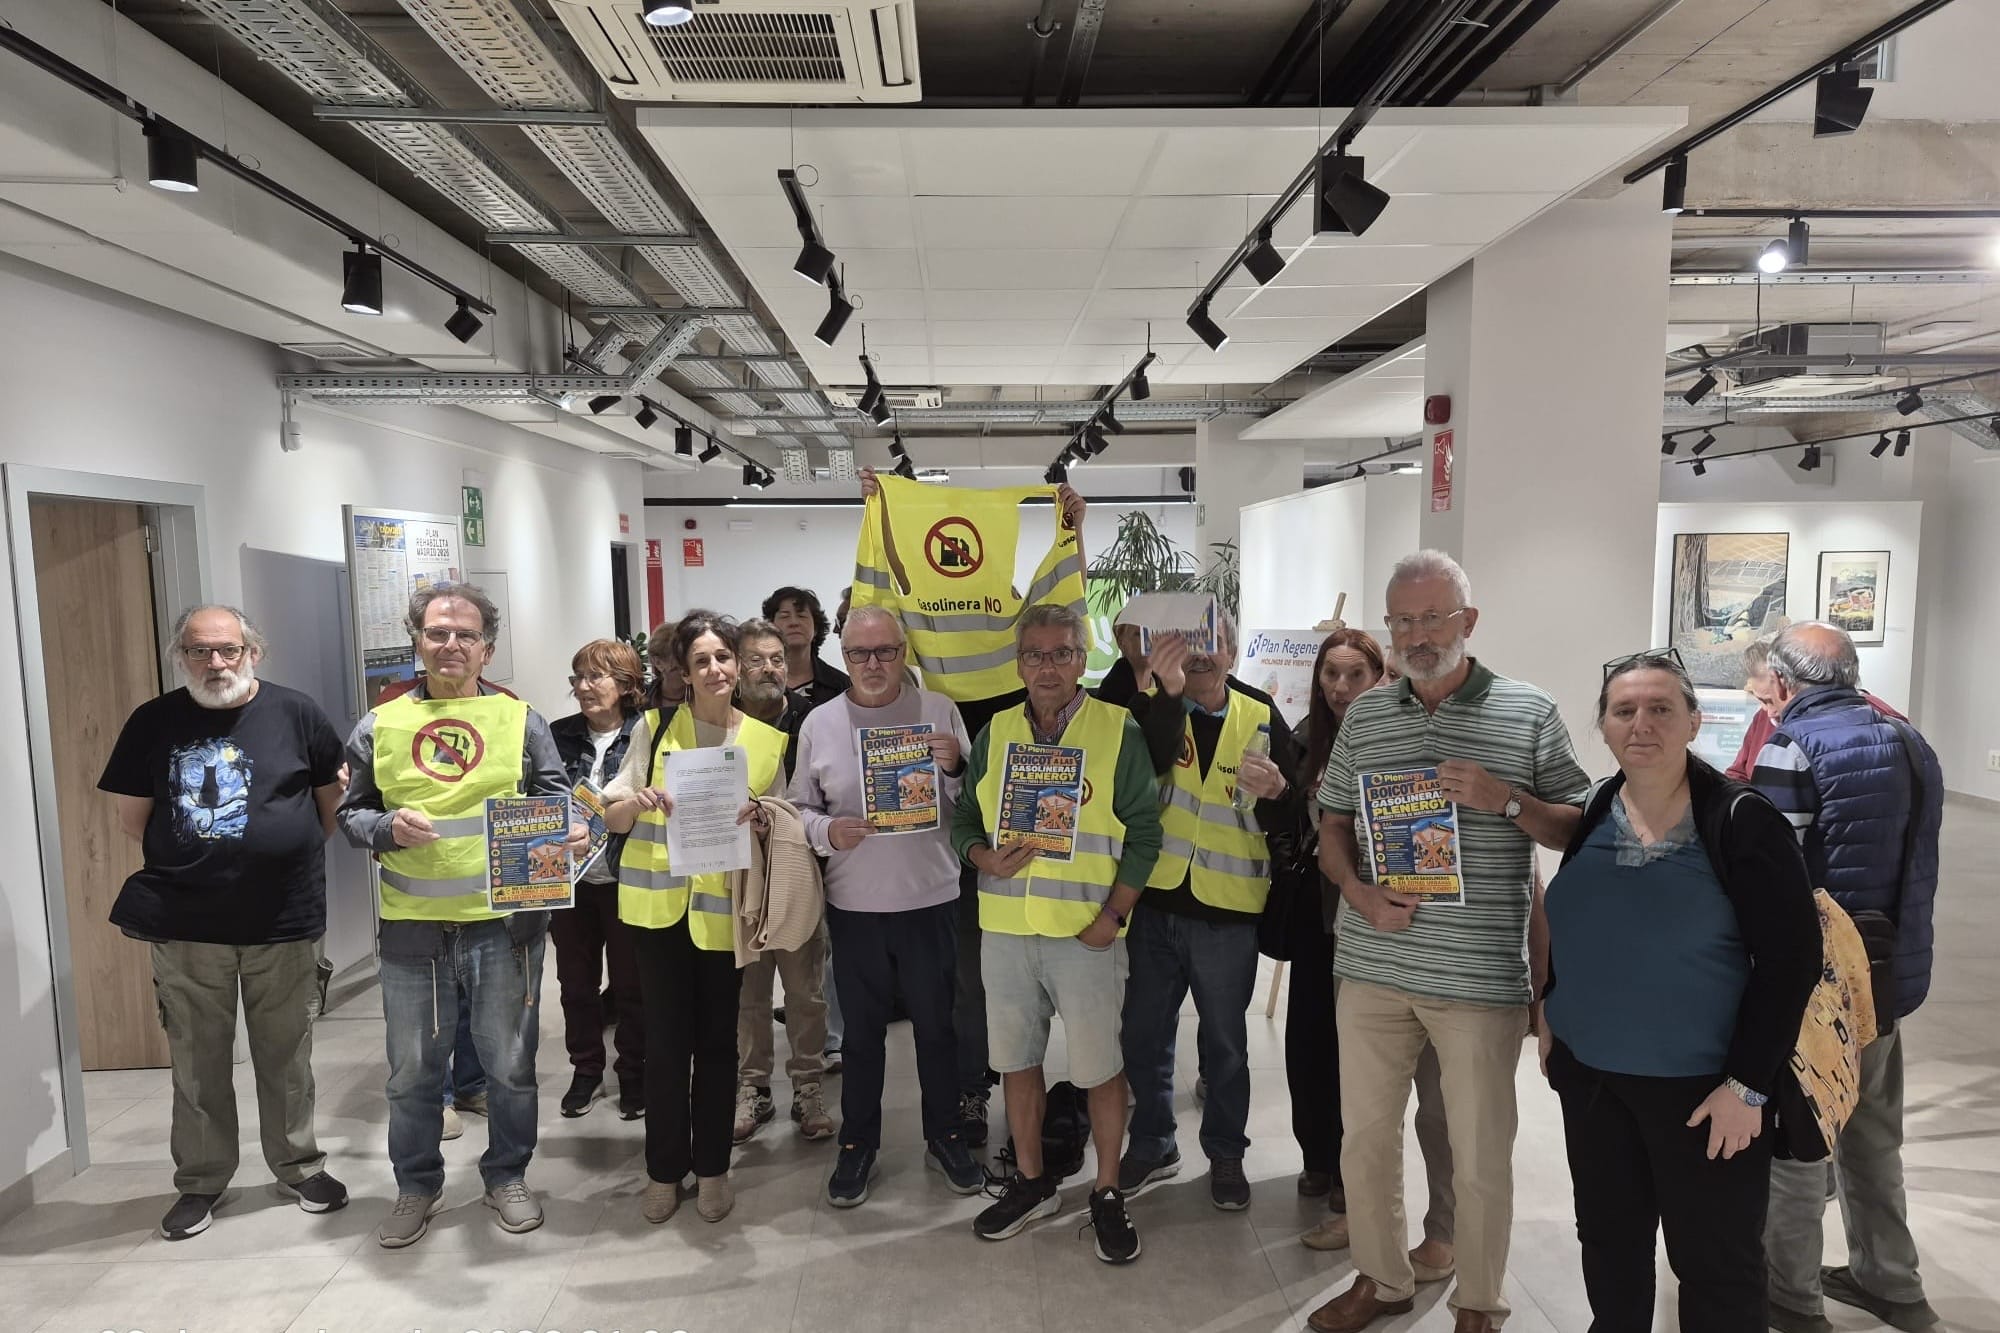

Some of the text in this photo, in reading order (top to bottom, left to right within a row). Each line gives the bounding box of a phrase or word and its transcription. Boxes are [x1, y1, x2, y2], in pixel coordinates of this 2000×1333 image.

[984, 595, 1002, 613] NO
[1261, 638, 1319, 658] Plan Regene
[866, 736, 904, 750] BOICOT
[867, 748, 929, 764] PLENERGY
[1012, 754, 1051, 766] BOICOT
[1010, 771, 1077, 781] PLENERGY
[1011, 765, 1077, 773] GASOLINERAS
[1370, 782, 1415, 800] BOICOT
[1425, 781, 1440, 790] LAS
[491, 808, 535, 820] BOICOT
[1372, 799, 1447, 817] PLENERGY
[493, 815, 564, 828] GASOLINERAS
[493, 820, 564, 836] PLENERGY
